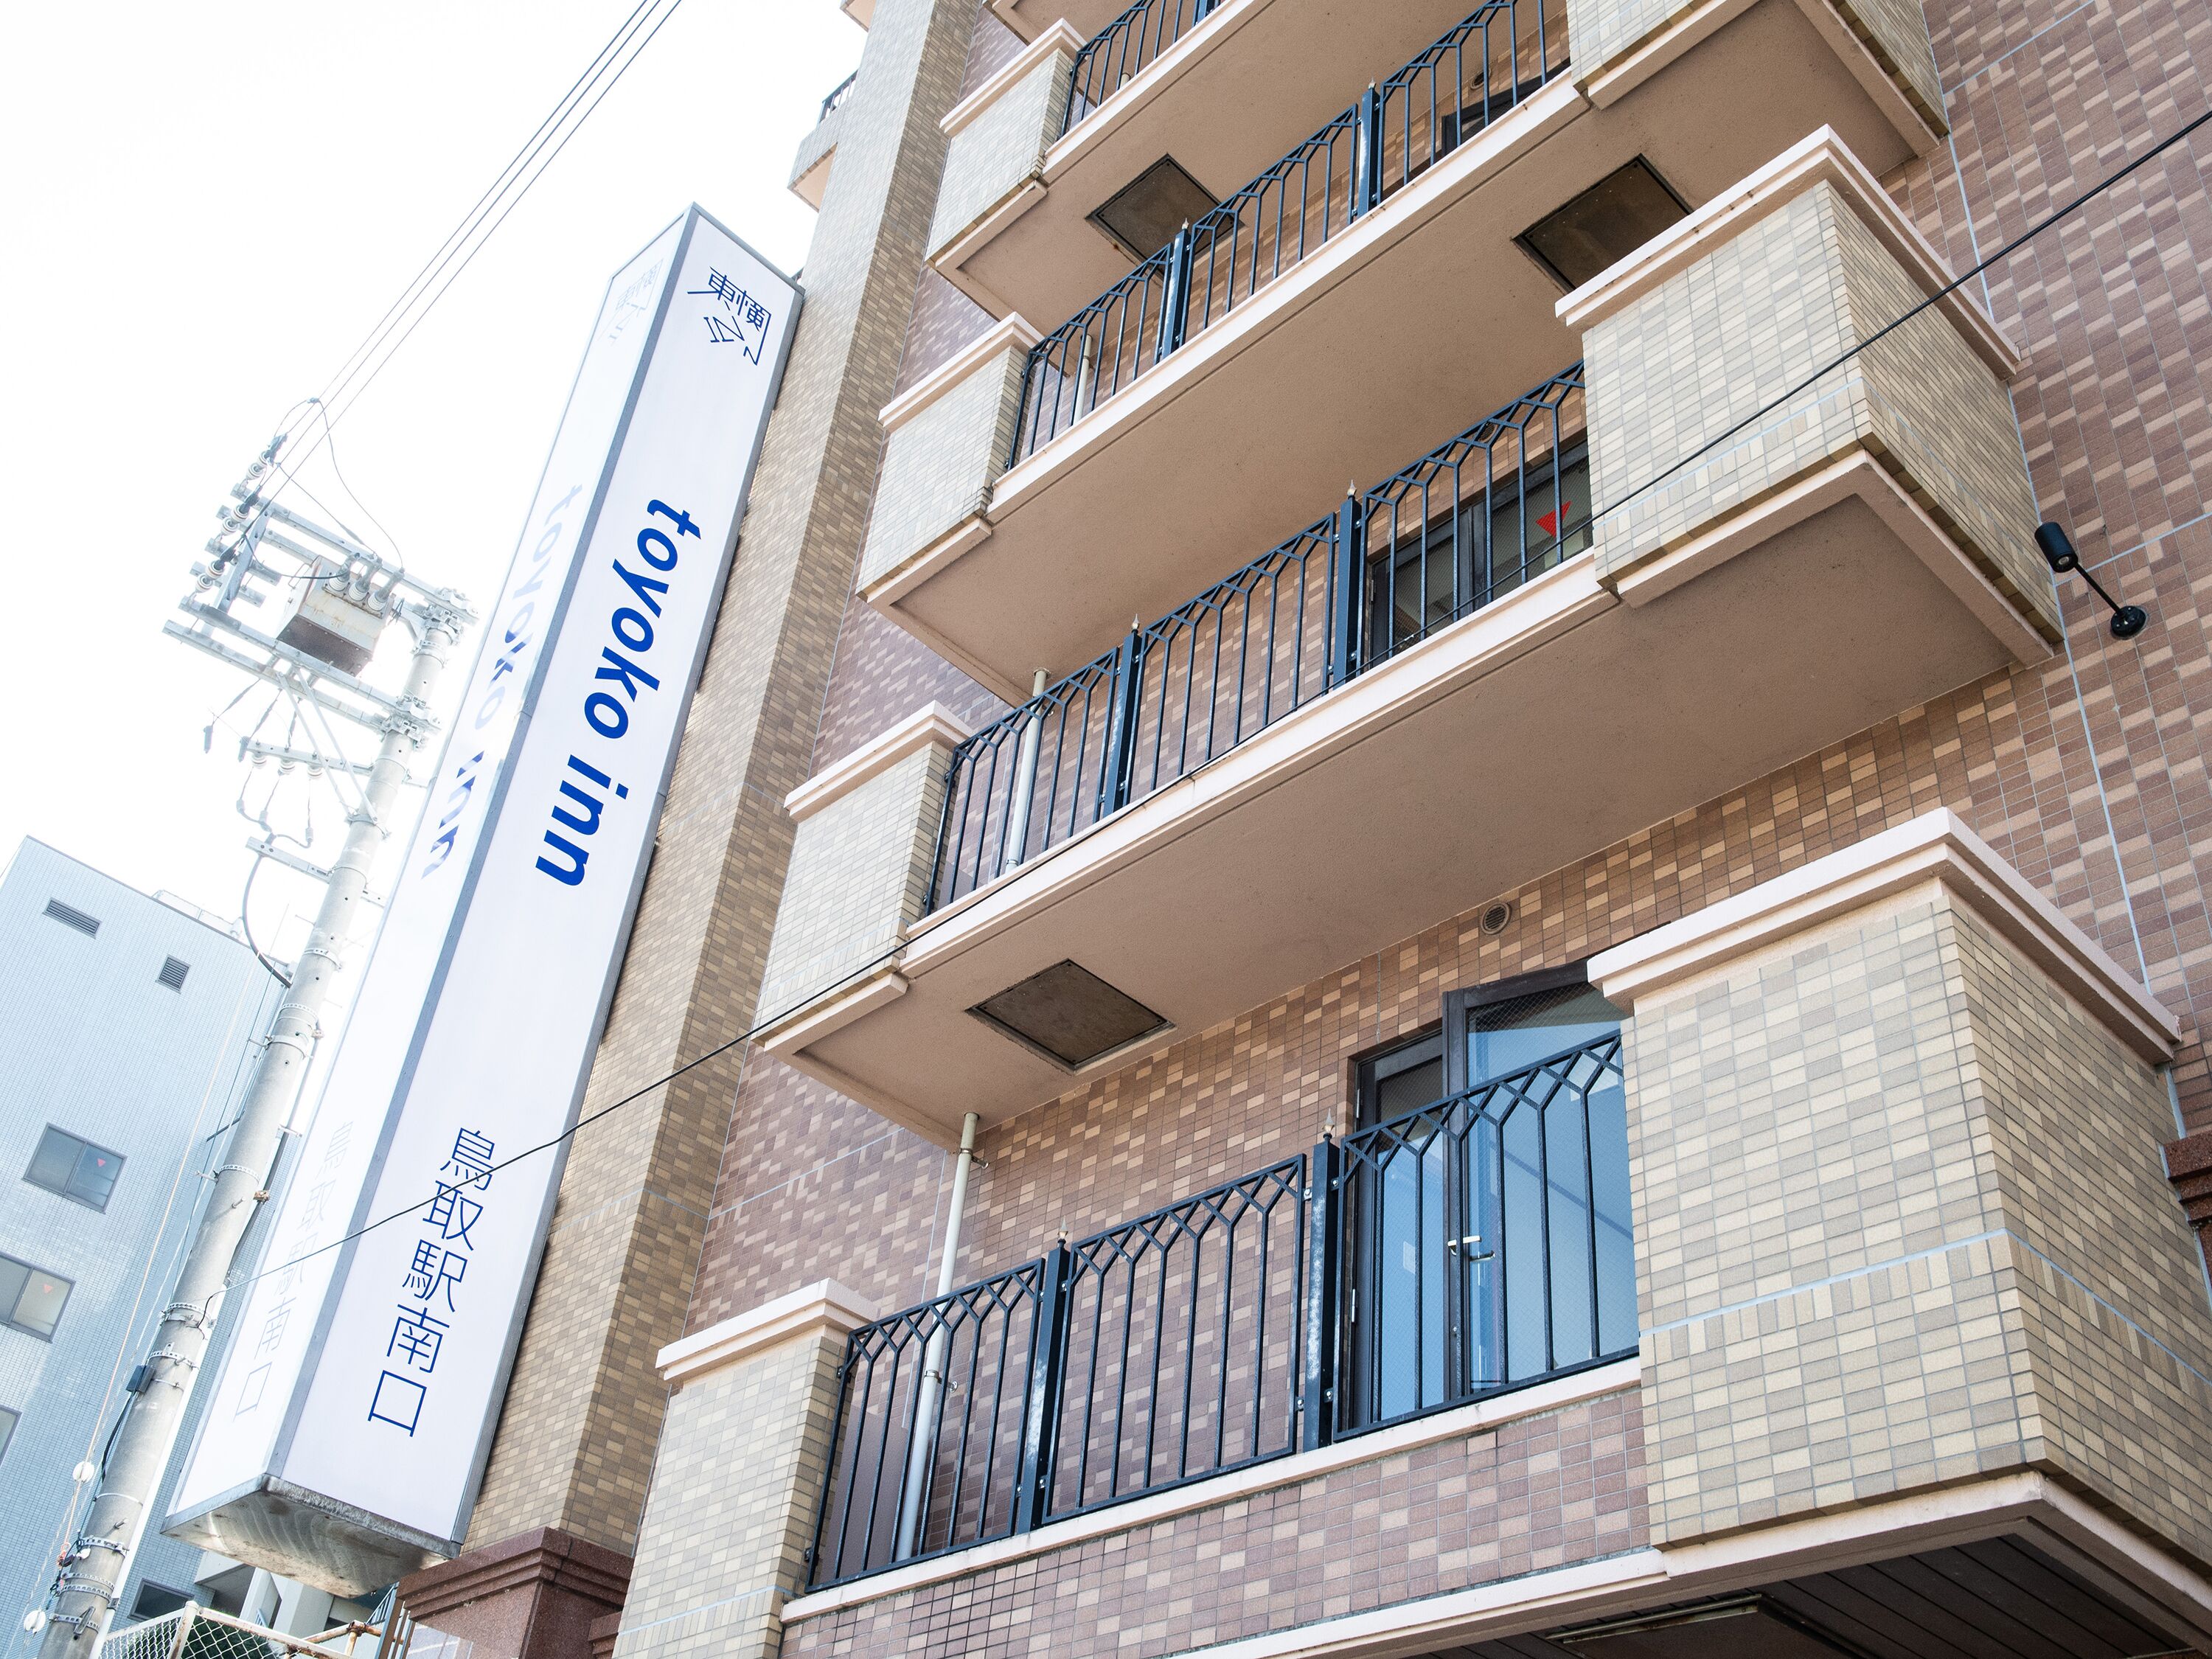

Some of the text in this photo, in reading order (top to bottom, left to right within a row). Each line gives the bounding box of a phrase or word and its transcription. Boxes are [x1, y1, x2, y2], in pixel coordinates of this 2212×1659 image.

[421, 484, 582, 880] toyoko inn
[535, 499, 701, 886] toyoko inn
[368, 1127, 495, 1437] 鳥取駅南口
